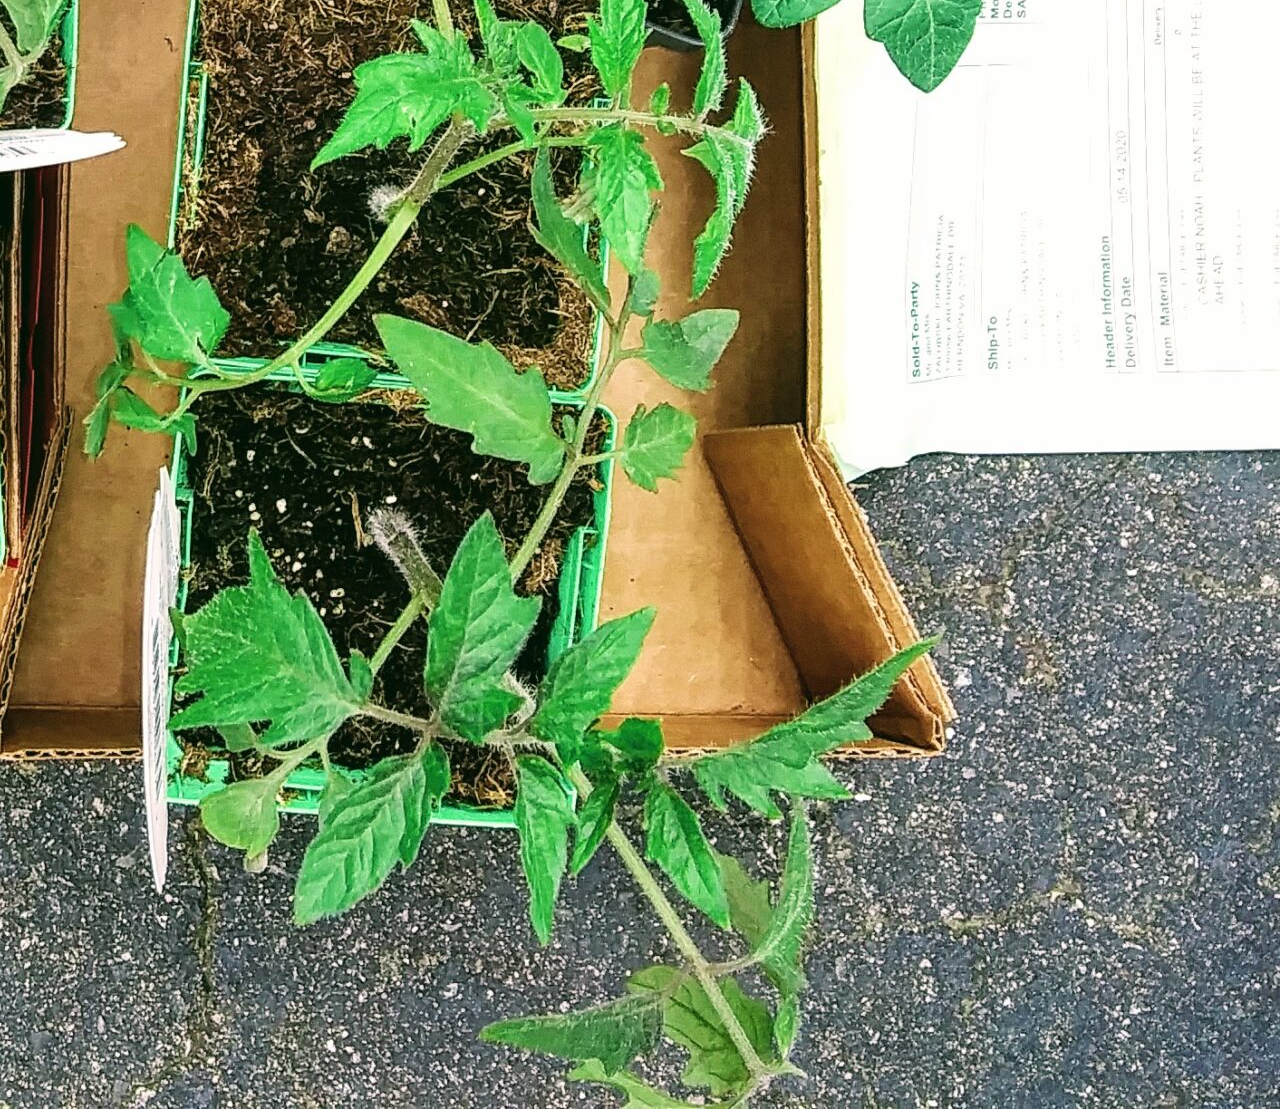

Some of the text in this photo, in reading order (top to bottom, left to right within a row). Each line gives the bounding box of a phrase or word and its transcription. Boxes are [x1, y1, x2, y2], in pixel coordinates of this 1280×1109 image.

[1192, 195, 1206, 237] NOAH
[1120, 276, 1132, 307] Date
[1192, 242, 1208, 305] CASHIER
[1212, 255, 1226, 305] AHEAD
[910, 281, 920, 377] Sold-To-Party
[1100, 235, 1116, 369] Header Information
[1158, 271, 1174, 366] Item Material
[987, 315, 999, 370] Ship-To
[1122, 312, 1136, 368] Delivery
